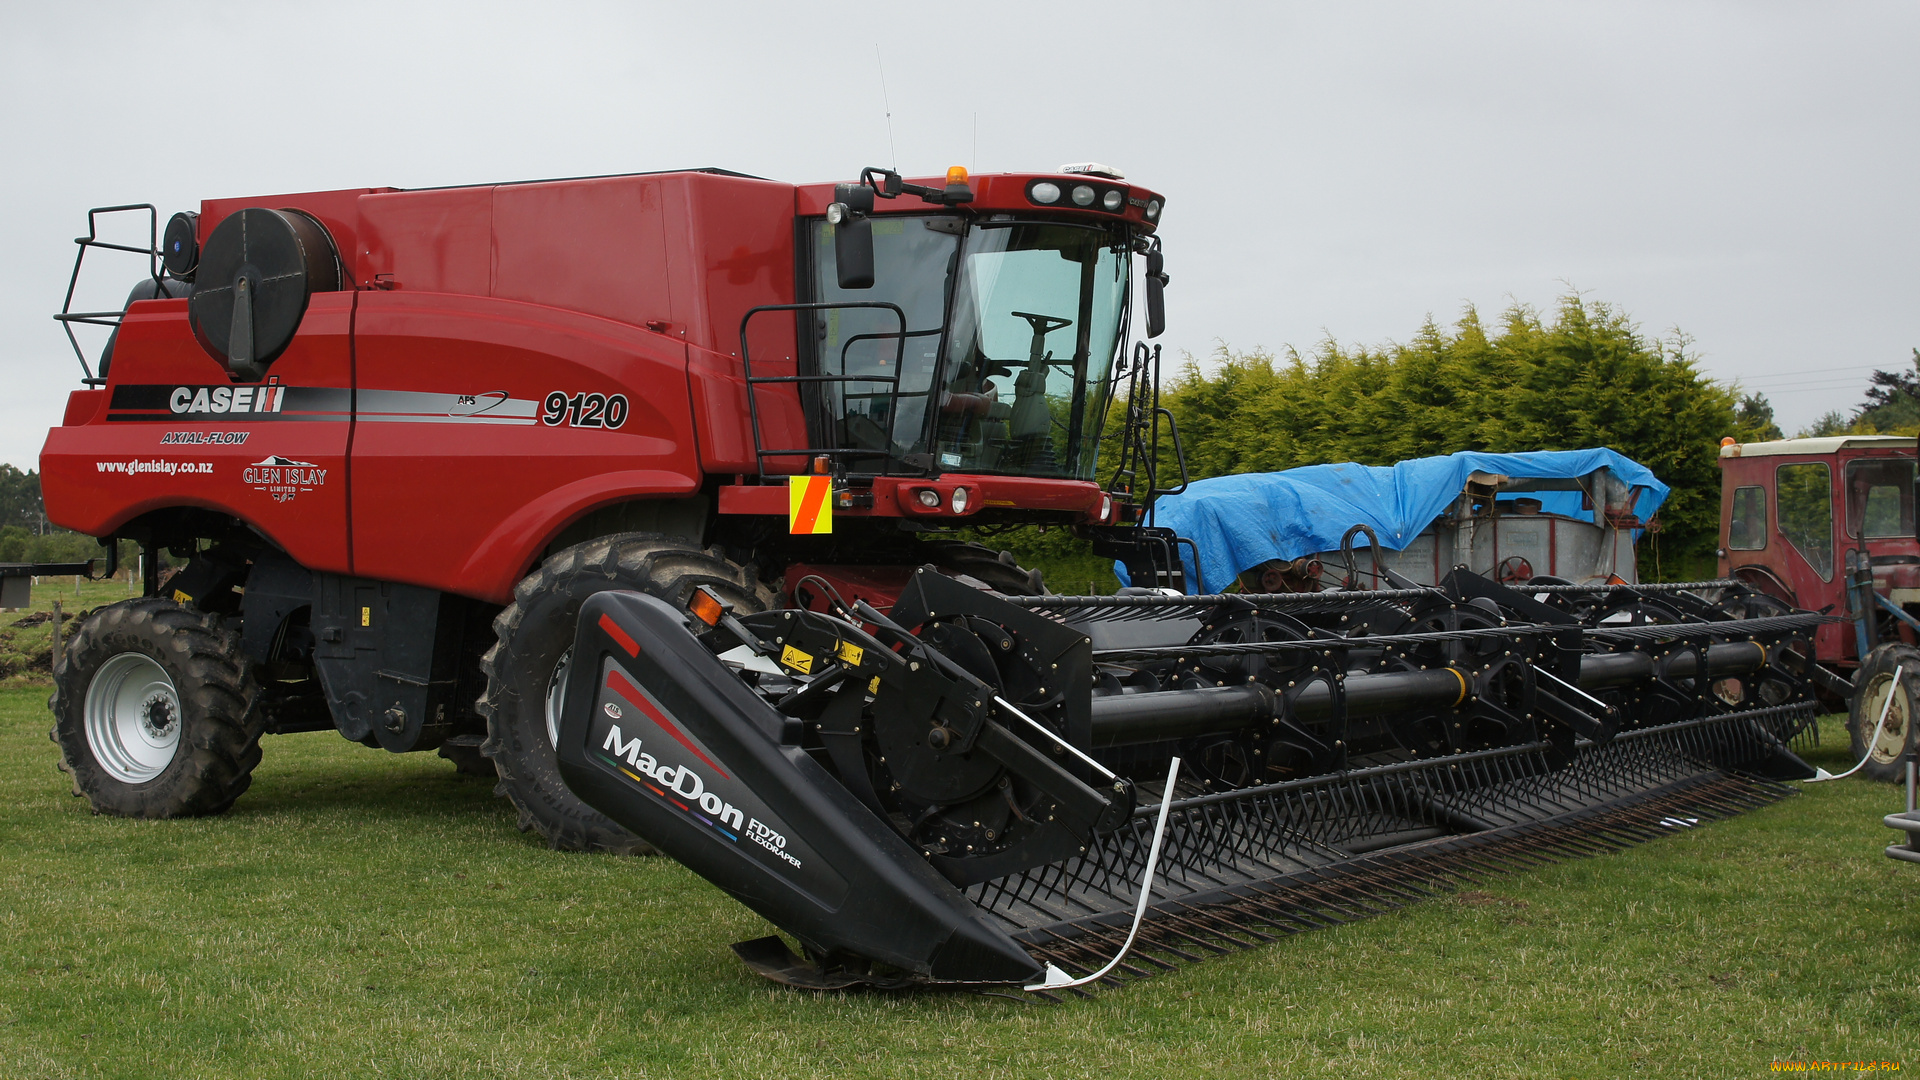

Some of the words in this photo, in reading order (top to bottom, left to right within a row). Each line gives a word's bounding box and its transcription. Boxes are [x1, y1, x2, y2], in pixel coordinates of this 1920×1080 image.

[170, 387, 253, 414] CASE
[457, 395, 476, 405] AFS
[542, 390, 630, 430] 9120
[160, 431, 250, 445] AXIAL-FLOW
[96, 459, 213, 476] www.glenislay.co.nz
[242, 467, 281, 485] GLEN
[286, 469, 327, 485] ISLAY
[270, 485, 296, 493] LIMITED
[602, 724, 744, 831] MacDon
[748, 817, 787, 849] FD70
[745, 829, 802, 869] FLEXDRAPER
